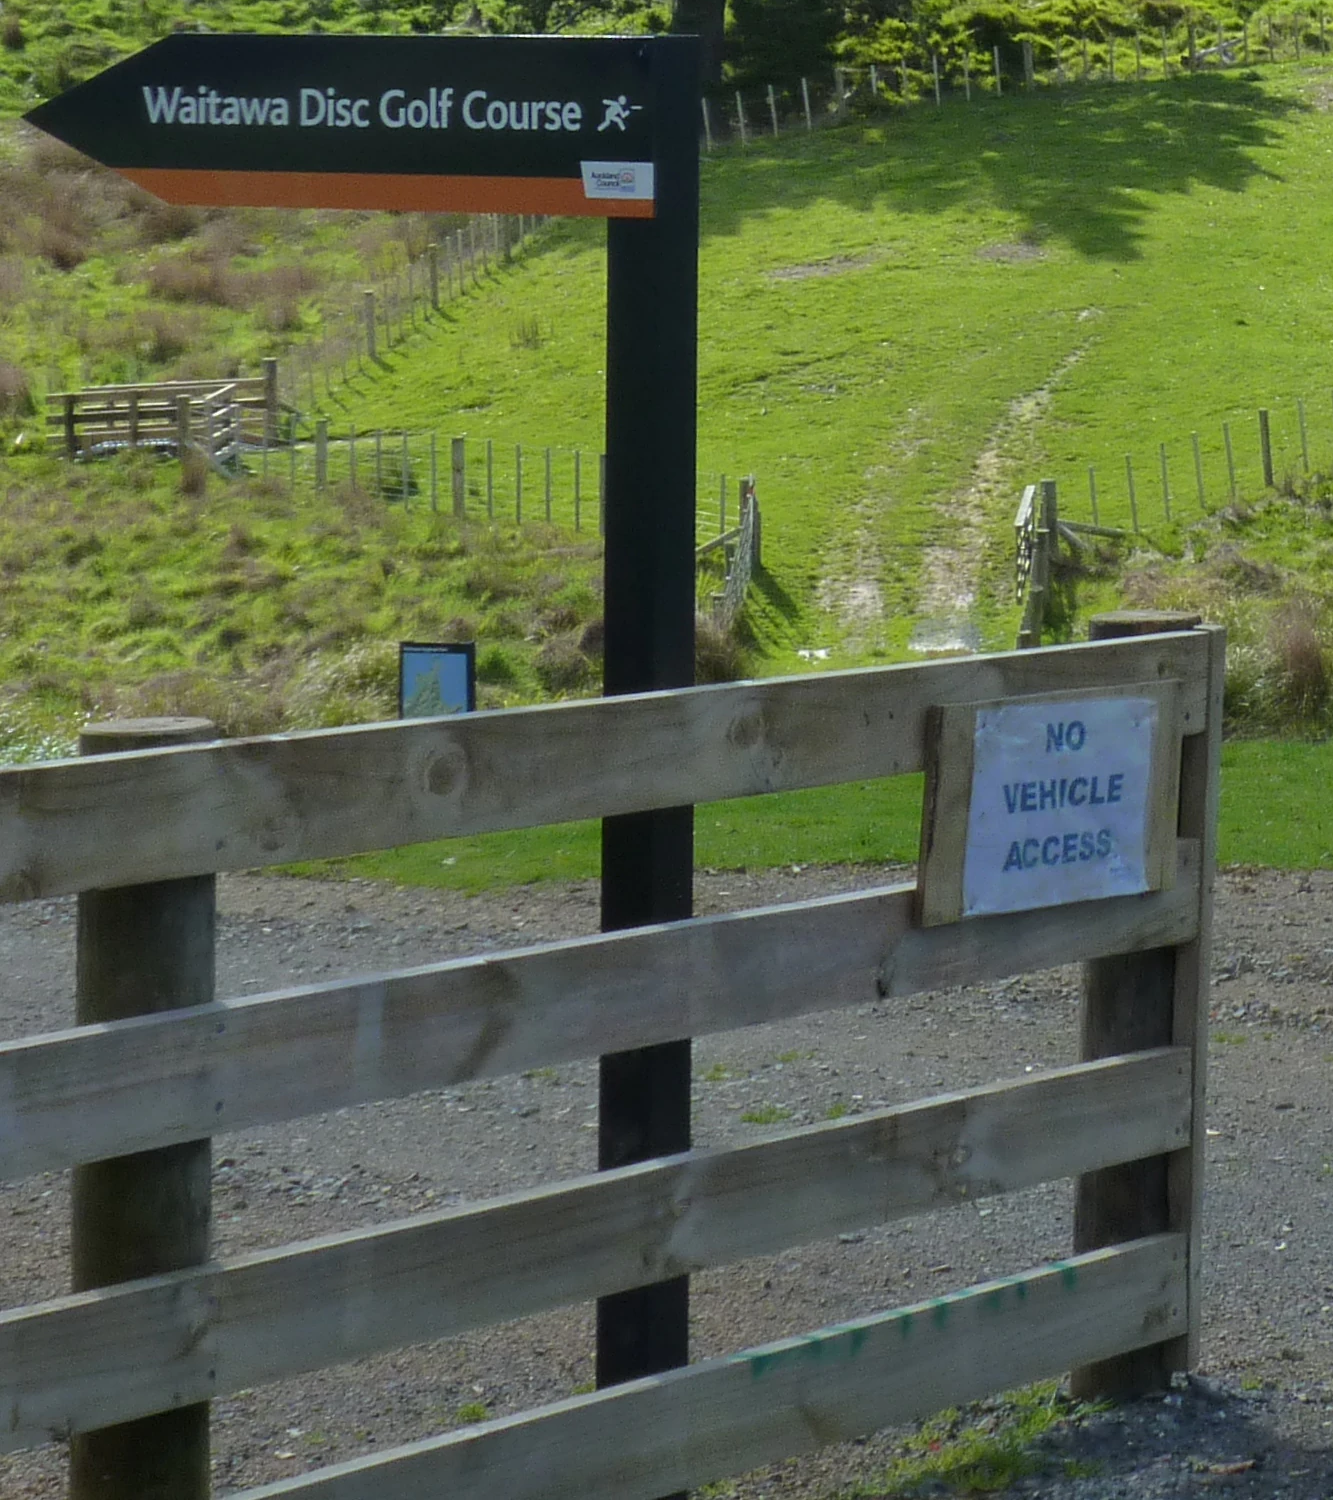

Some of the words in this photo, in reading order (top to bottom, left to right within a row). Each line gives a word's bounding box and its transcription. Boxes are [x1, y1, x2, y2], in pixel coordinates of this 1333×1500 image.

[142, 86, 289, 126] Waitawa
[300, 88, 370, 128] Disc
[379, 88, 454, 129] Golf
[462, 90, 582, 131] Course
[1046, 720, 1086, 752] NO
[1003, 773, 1123, 814] VEHICLE
[1003, 829, 1112, 871] ACCESS
